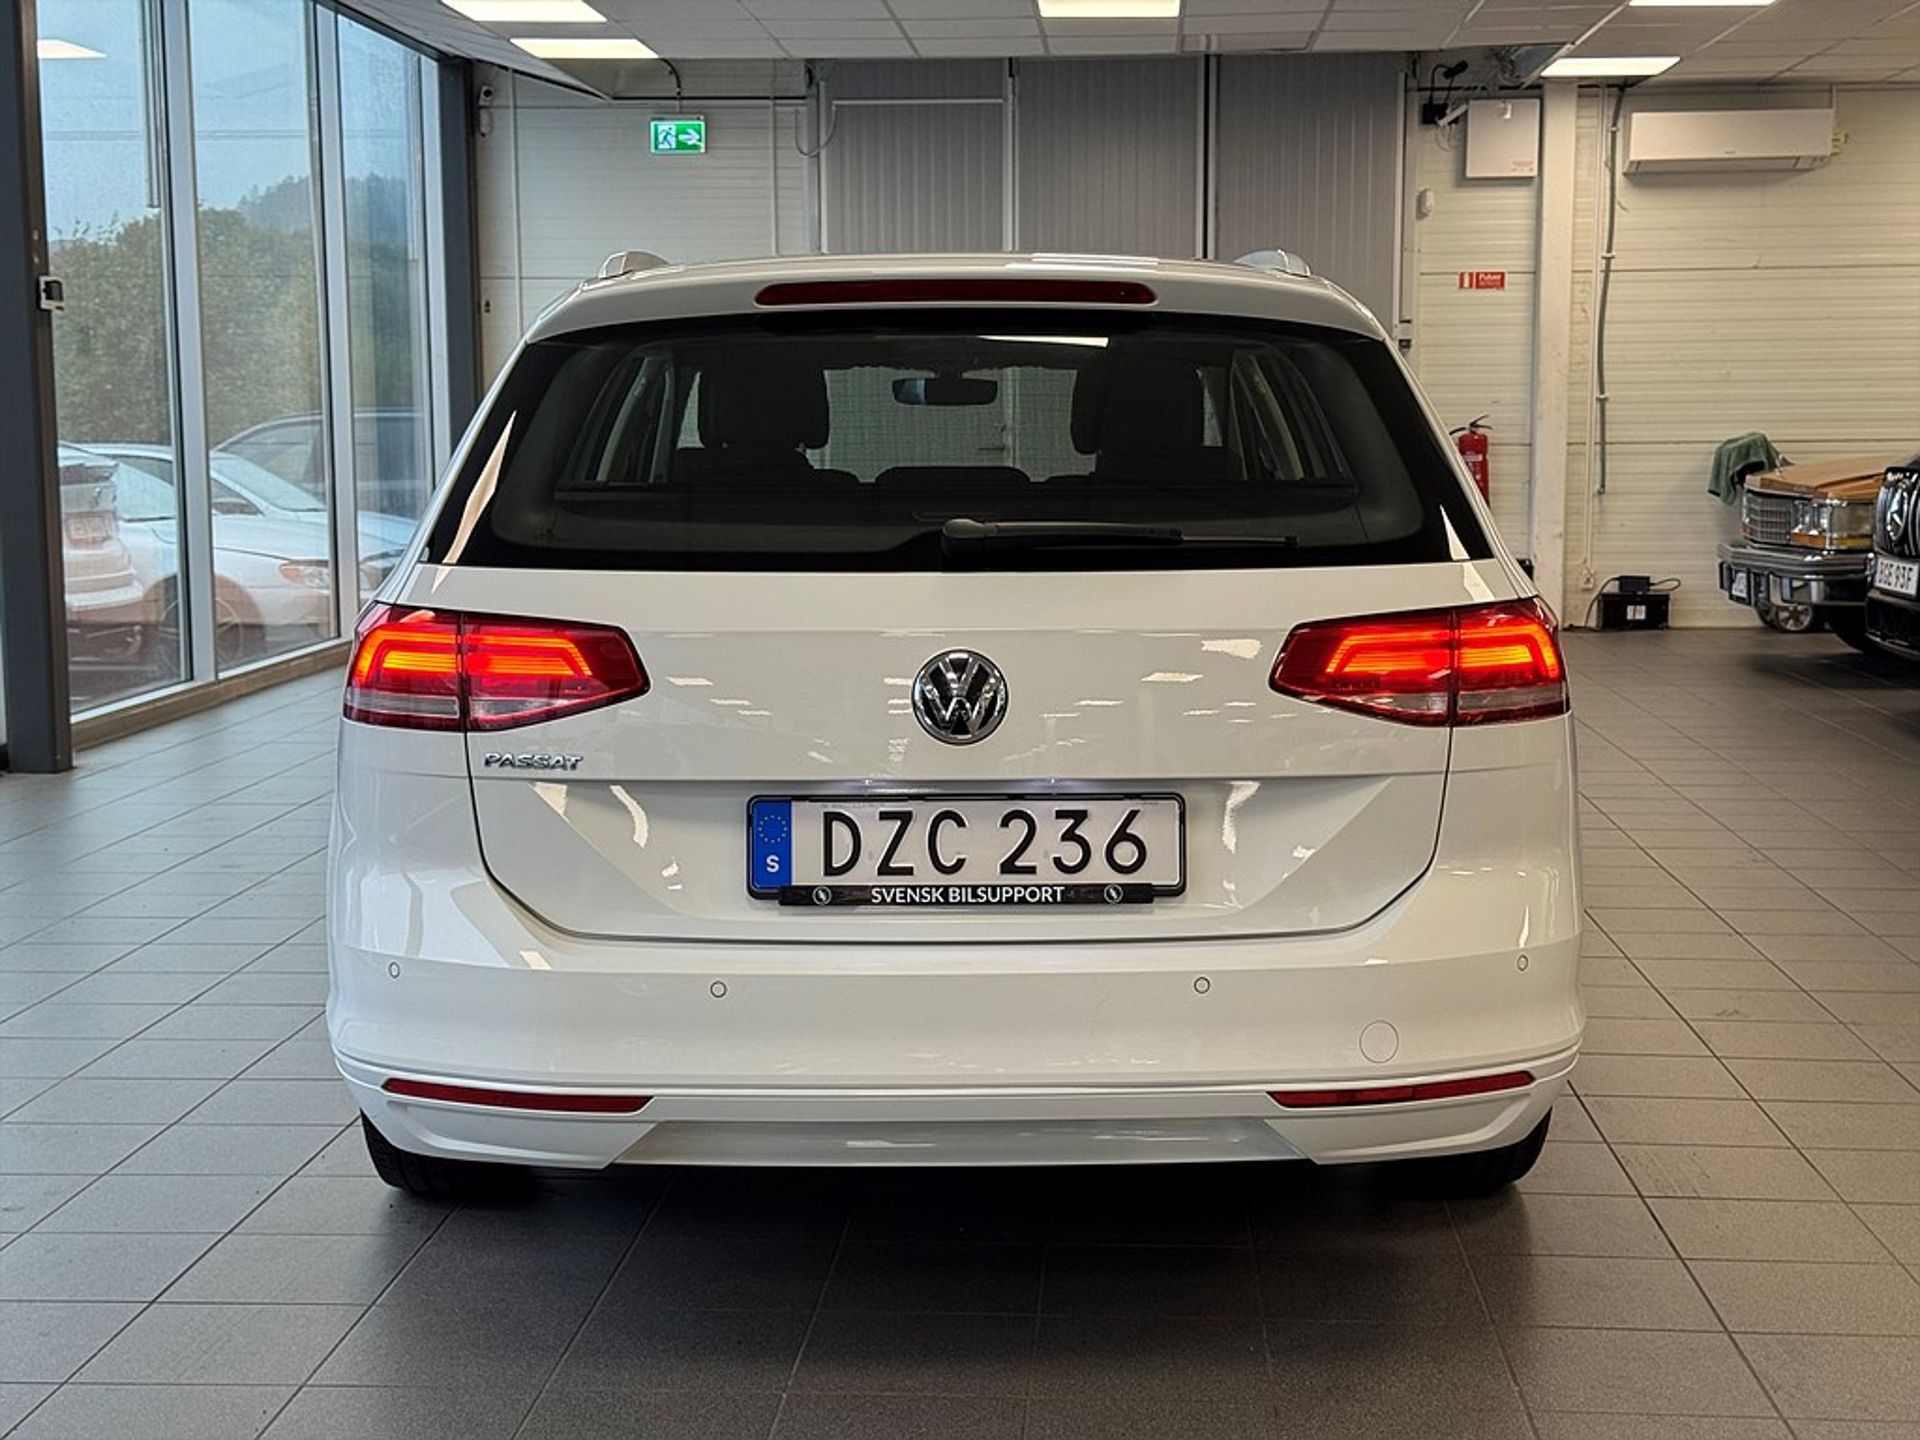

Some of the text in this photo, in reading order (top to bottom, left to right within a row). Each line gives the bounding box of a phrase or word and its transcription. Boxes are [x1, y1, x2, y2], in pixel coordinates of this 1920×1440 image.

[915, 652, 1004, 742] VW
[484, 752, 583, 770] PASSAT
[823, 809, 1147, 876] DZC 236
[766, 855, 780, 873] S
[871, 886, 1065, 903] SVENSK BILSUPPORT
